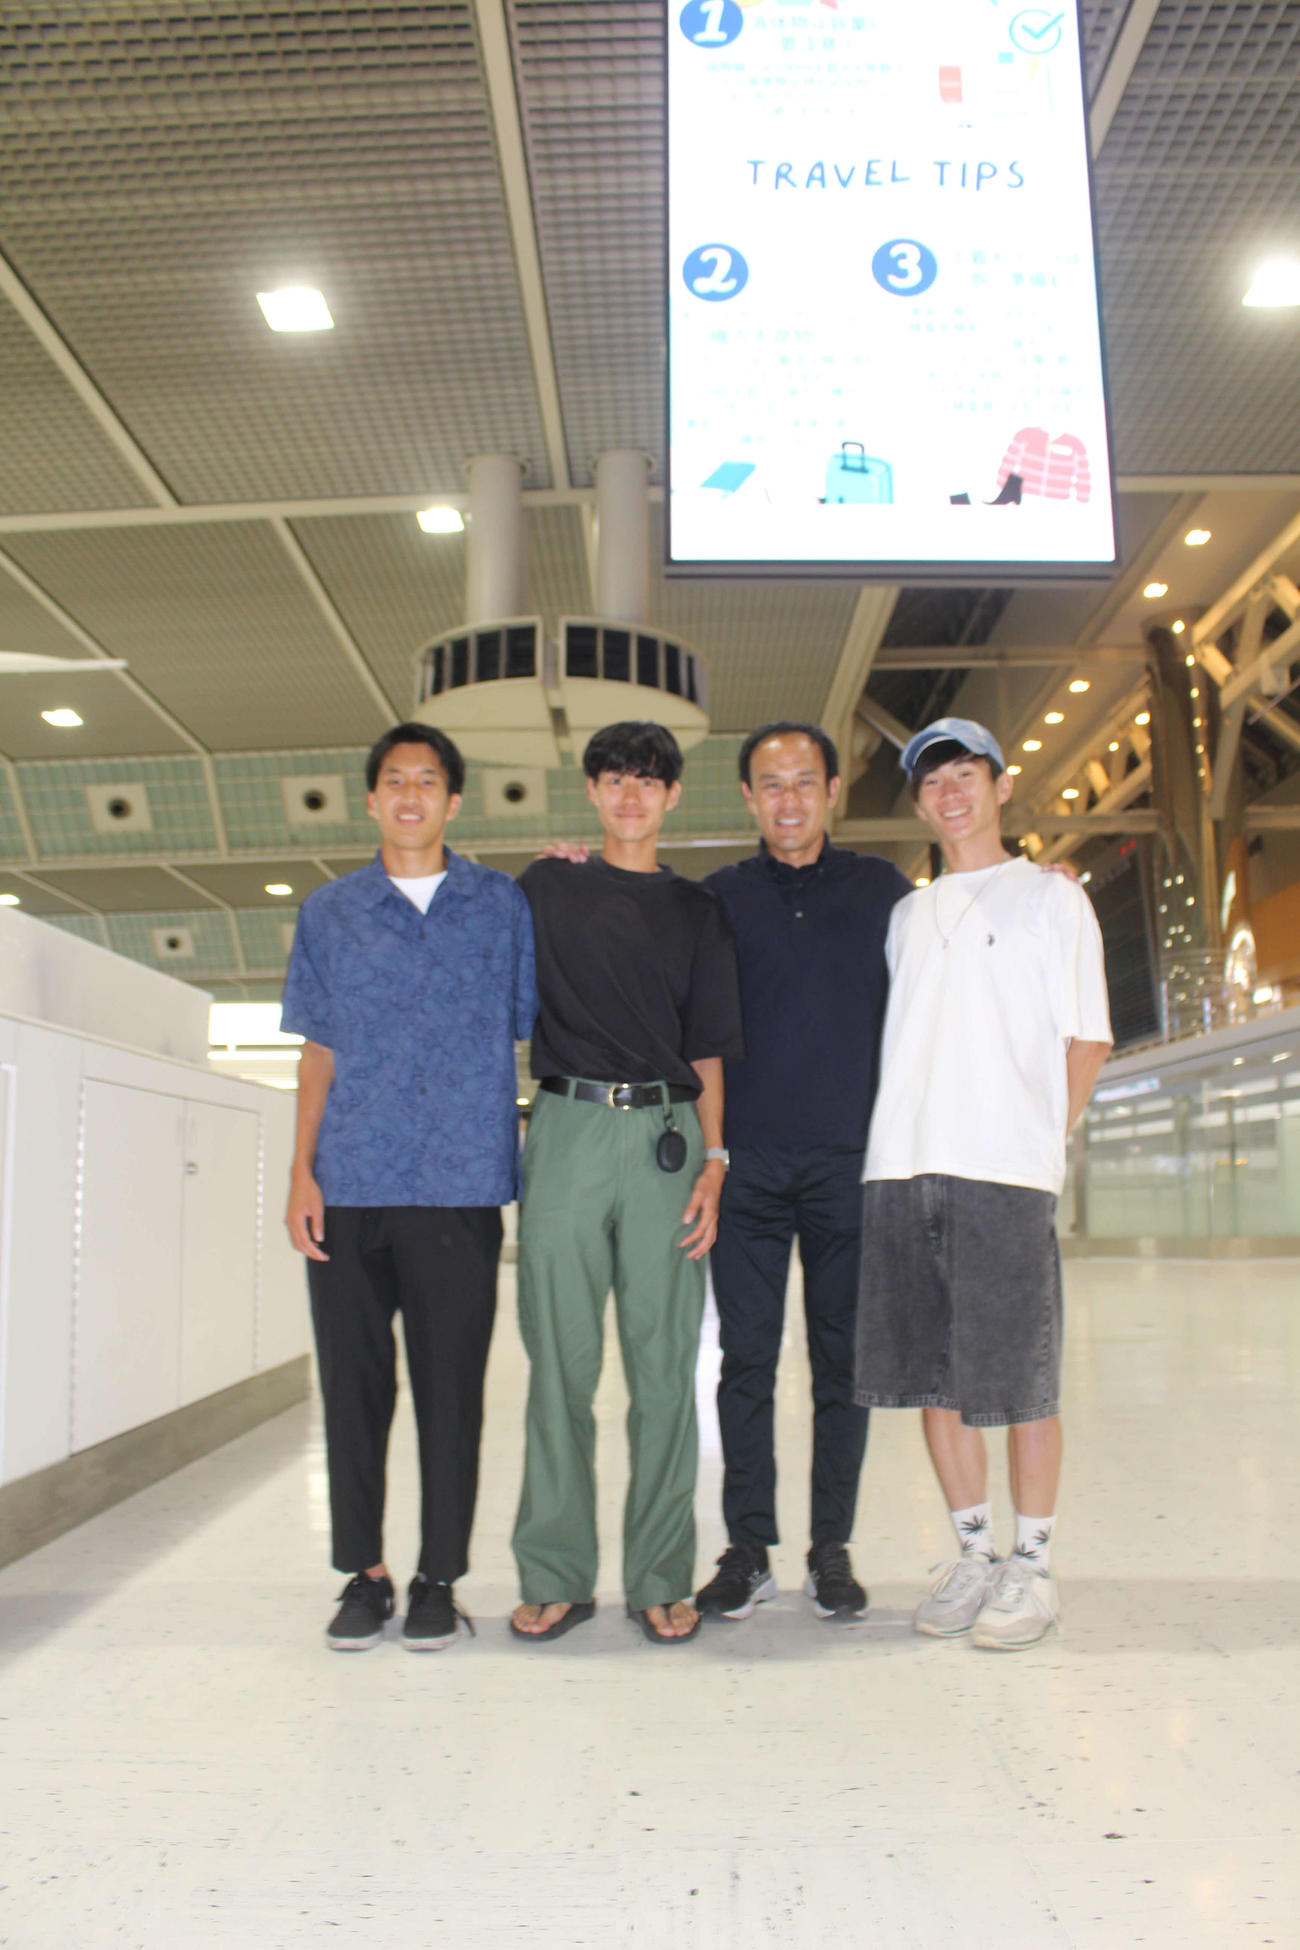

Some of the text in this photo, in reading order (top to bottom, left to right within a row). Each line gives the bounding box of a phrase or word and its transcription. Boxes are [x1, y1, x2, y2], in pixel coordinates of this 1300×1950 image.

[693, 0, 728, 42] 1
[746, 158, 1024, 191] TRAVEL TIPS
[693, 247, 738, 294] 2
[887, 242, 923, 289] 3
